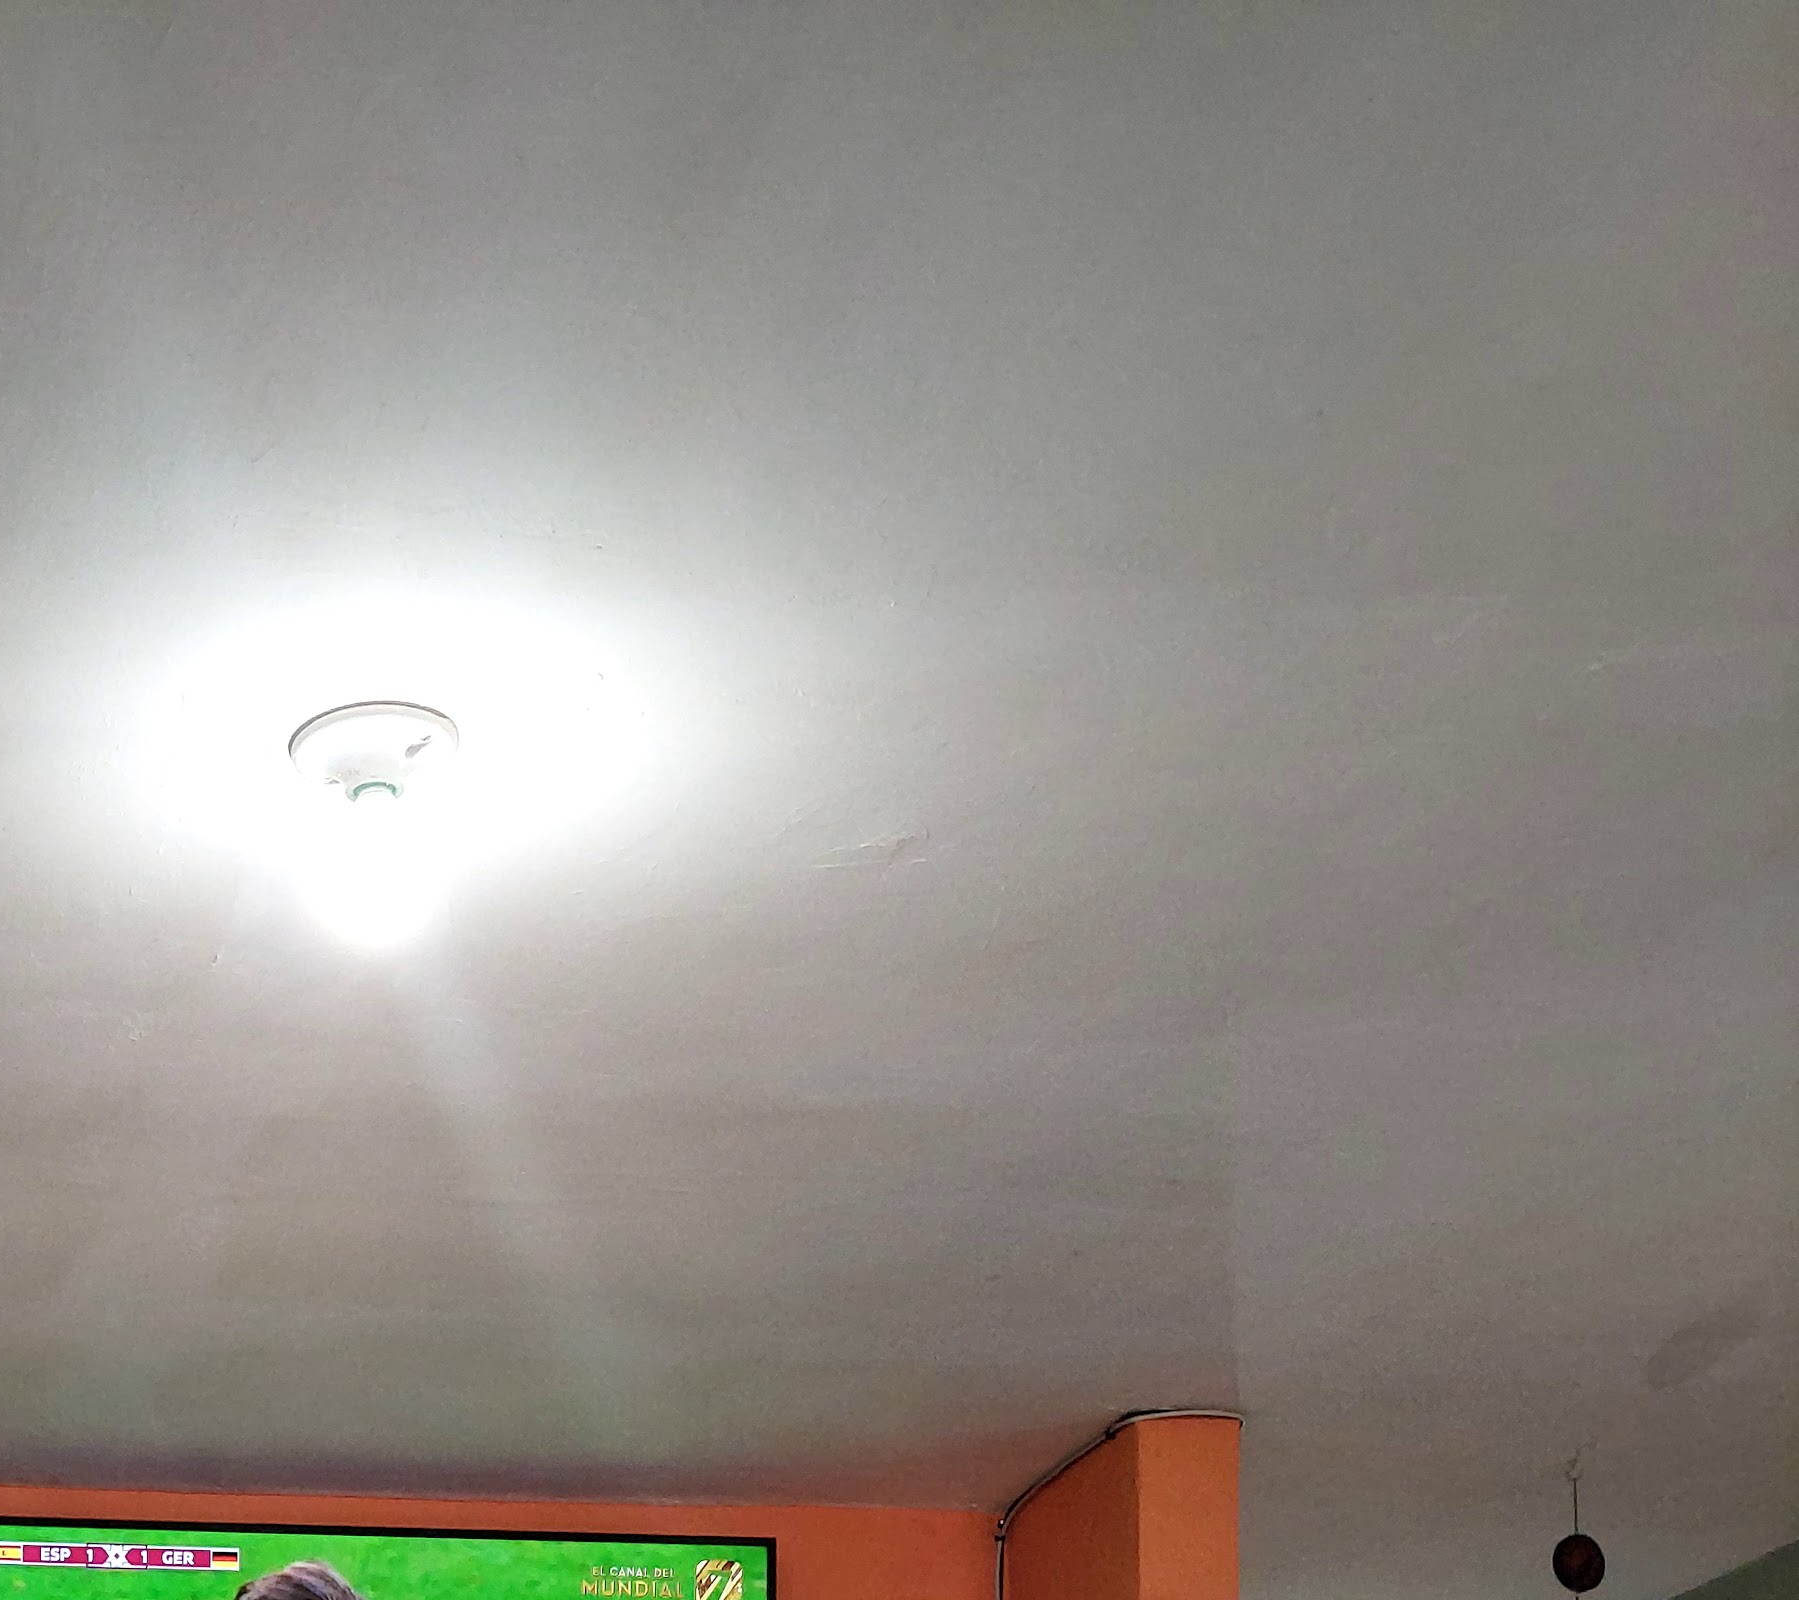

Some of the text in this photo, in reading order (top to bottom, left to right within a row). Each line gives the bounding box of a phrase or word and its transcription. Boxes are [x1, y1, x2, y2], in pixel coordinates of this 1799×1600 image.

[39, 1547, 94, 1562] ESP 1
[140, 1550, 195, 1566] 1 GER
[591, 1565, 606, 1577] EL
[609, 1566, 650, 1578] CANAL
[580, 1578, 686, 1600] MUNDIAL
